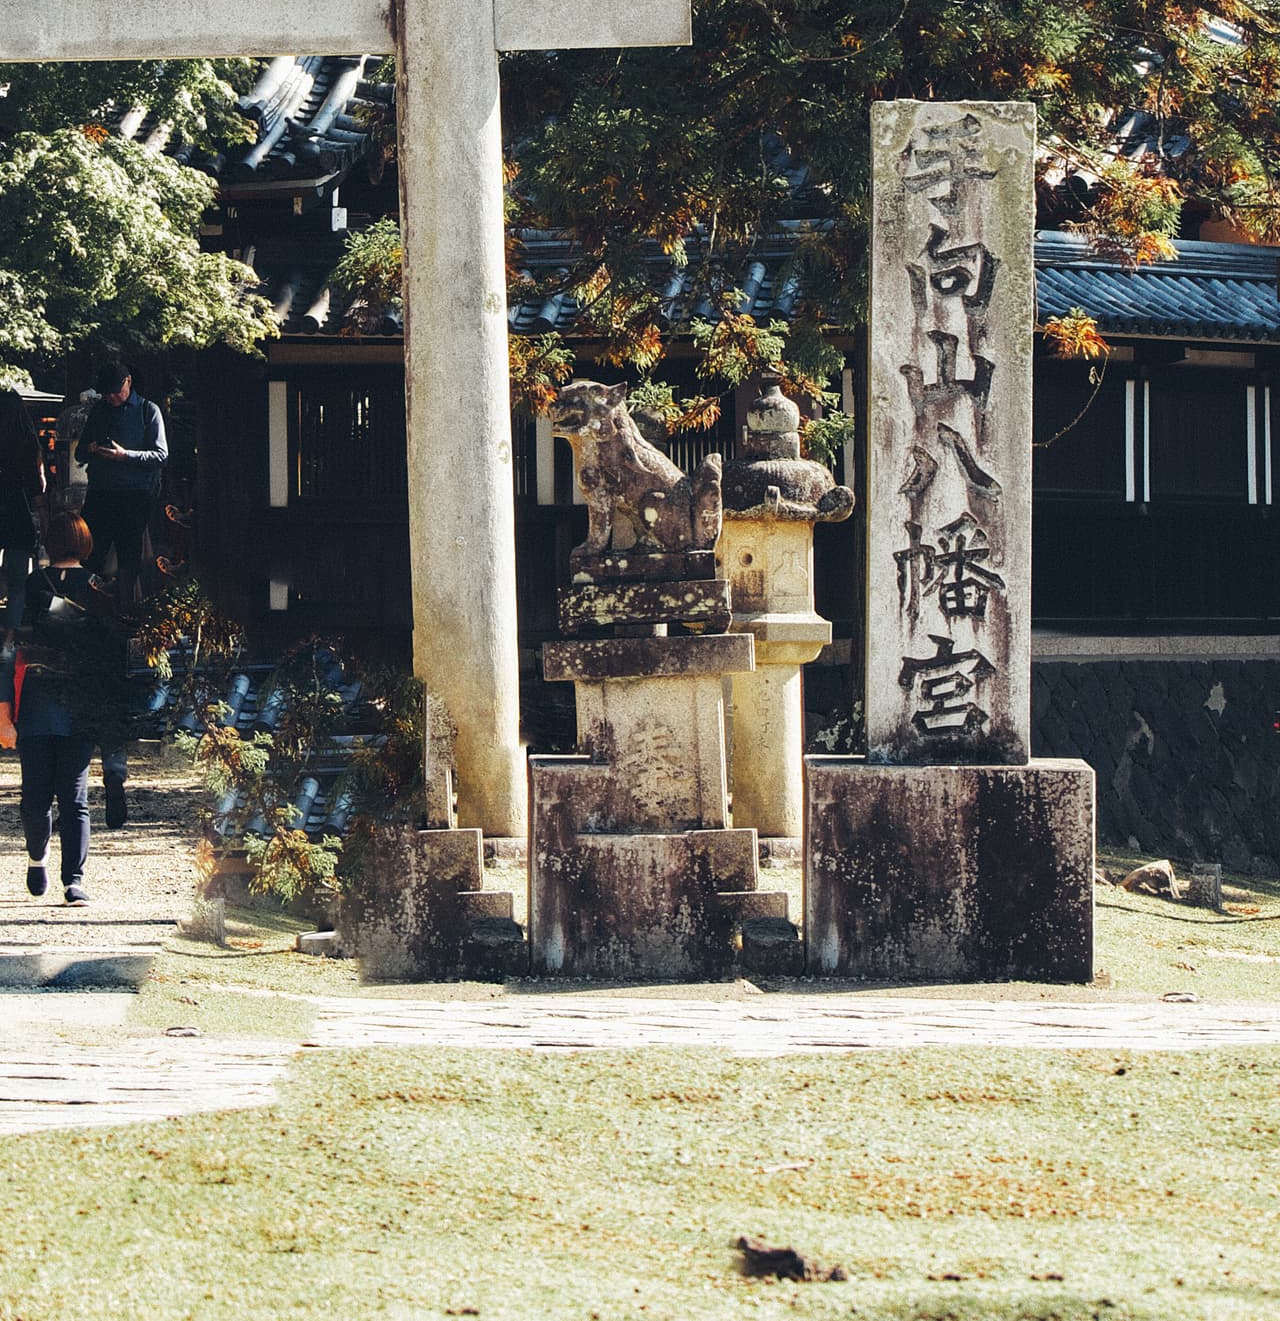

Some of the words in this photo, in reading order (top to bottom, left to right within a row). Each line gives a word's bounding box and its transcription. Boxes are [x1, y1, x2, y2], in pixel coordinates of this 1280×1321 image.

[894, 113, 1006, 738] 手向山八幡宮
